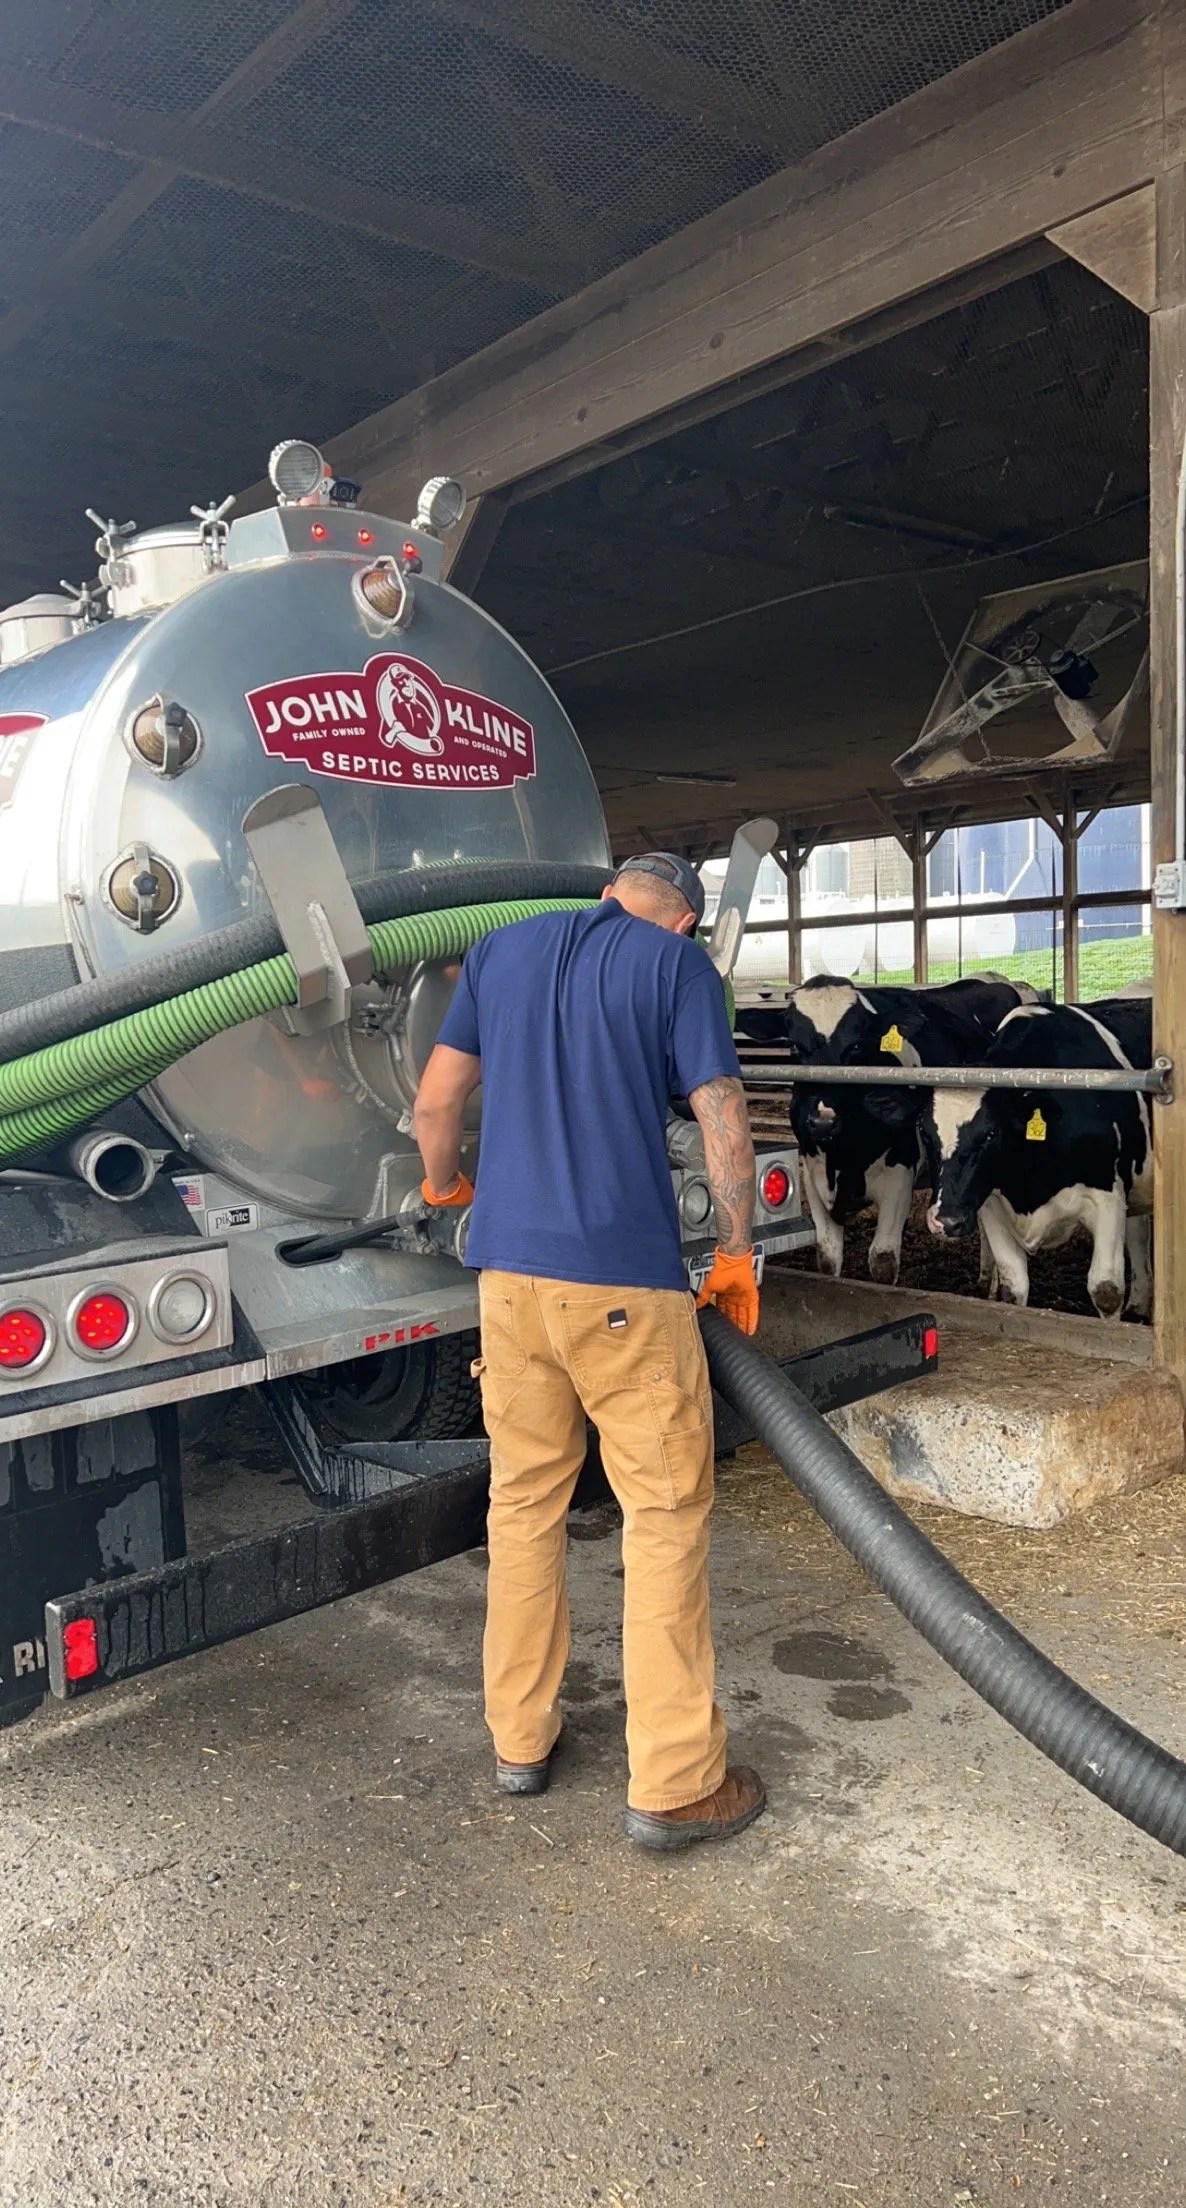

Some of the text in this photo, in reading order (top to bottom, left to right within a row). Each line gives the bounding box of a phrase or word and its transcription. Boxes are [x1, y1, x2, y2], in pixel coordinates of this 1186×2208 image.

[265, 688, 528, 757] JOHN KLINE
[292, 726, 508, 759] FAMILY OWNED AND OPERATED
[322, 751, 500, 781] SEPTIC SERVICES
[365, 1319, 440, 1351] PIK
[13, 1638, 46, 1677] RI
